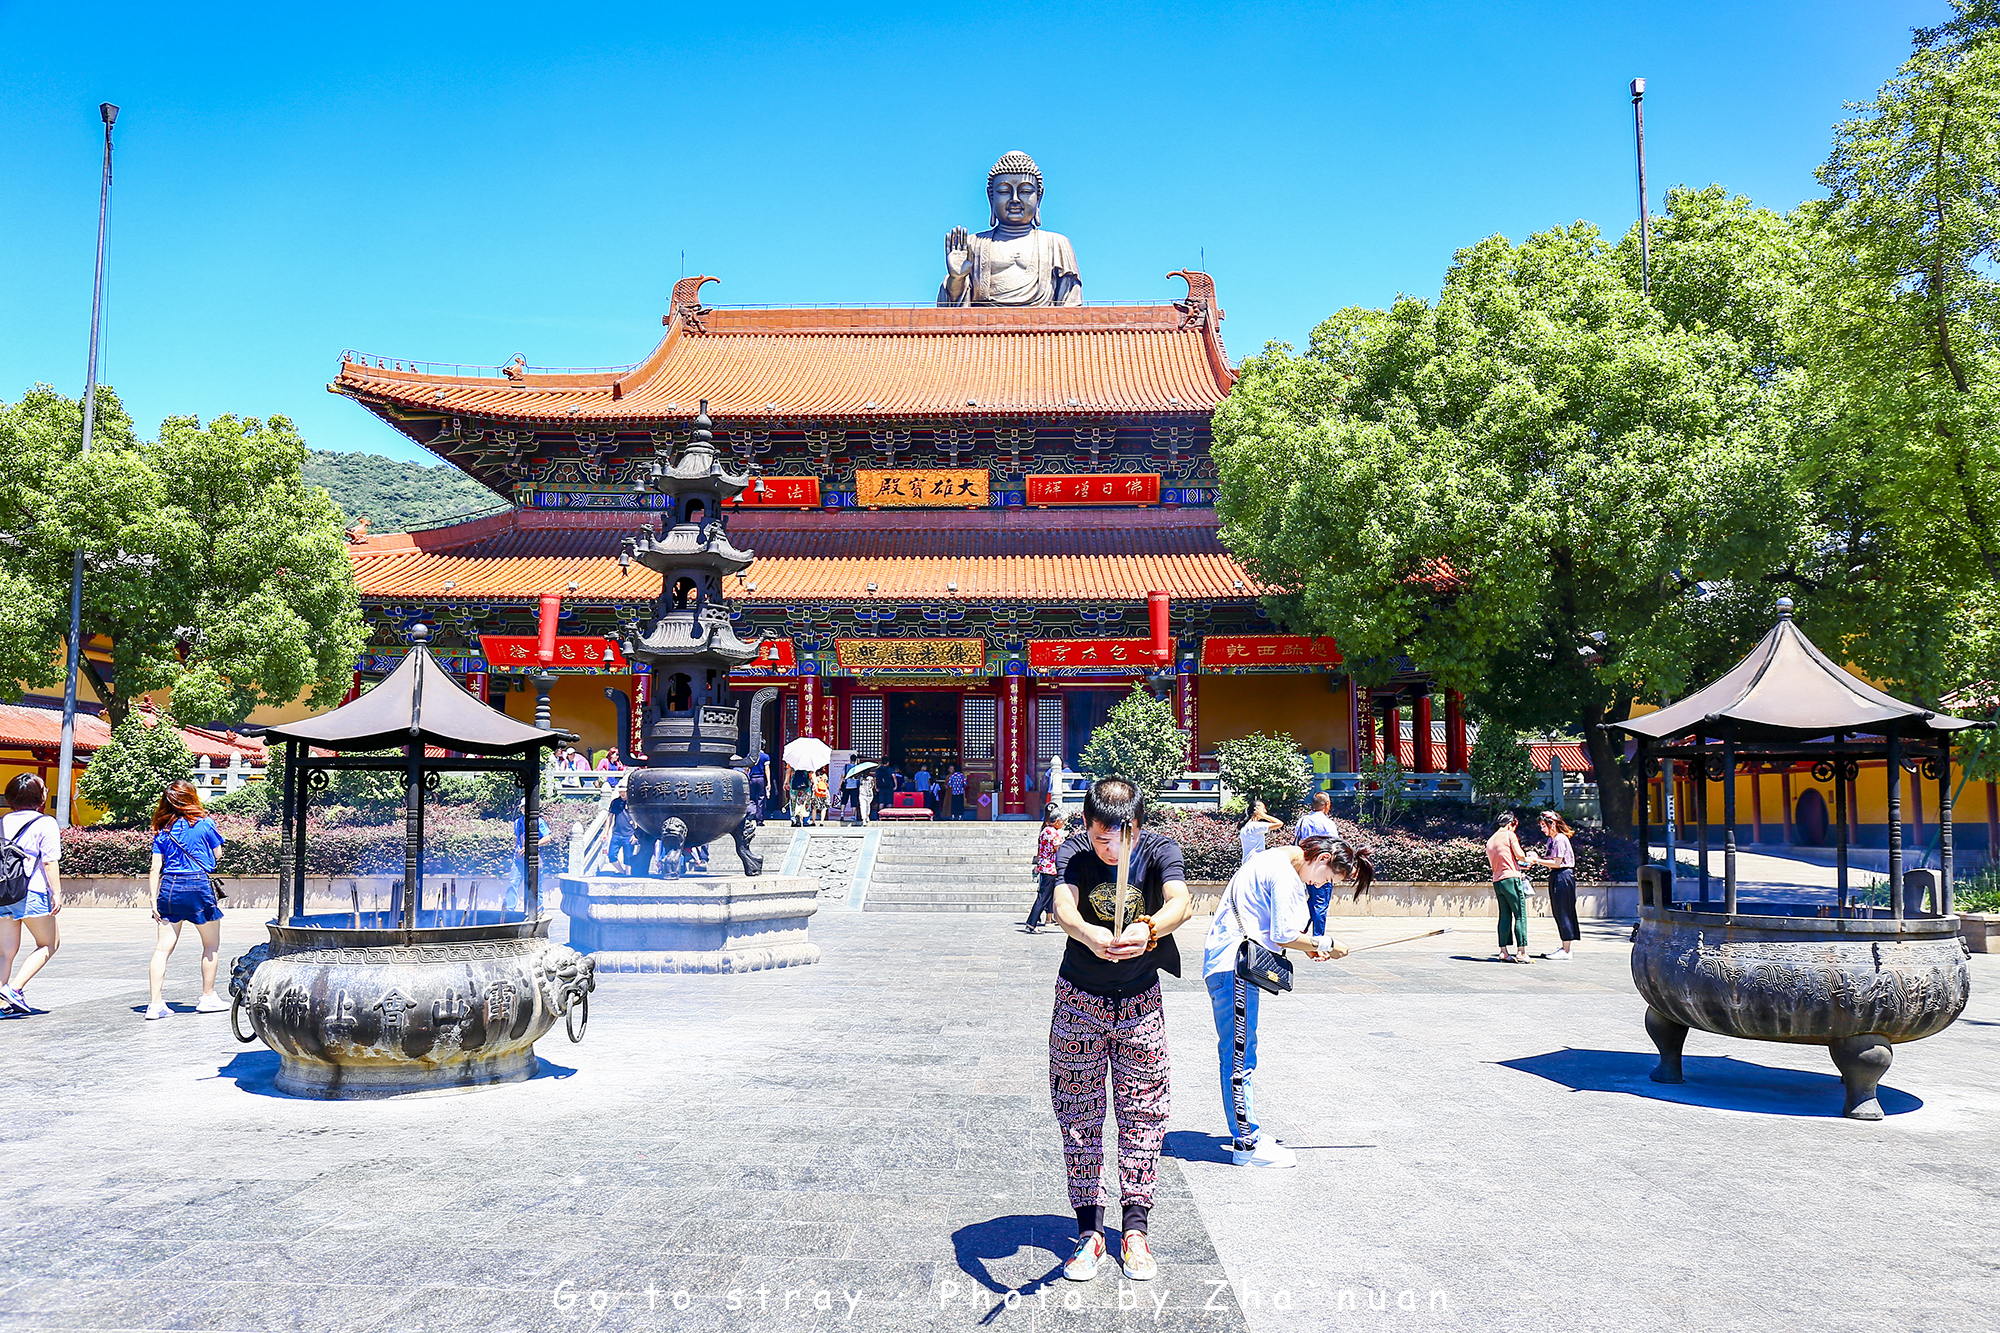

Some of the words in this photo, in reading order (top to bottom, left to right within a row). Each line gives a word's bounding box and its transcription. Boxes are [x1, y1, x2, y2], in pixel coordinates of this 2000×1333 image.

[874, 478, 979, 499] 大雄寶殿
[638, 780, 715, 801] 祥符禪寺
[1235, 977, 1245, 1010] PINKO
[1235, 1014, 1246, 1045] PINKO
[1234, 1049, 1244, 1079] PINKO
[1233, 1084, 1245, 1116] PINKO
